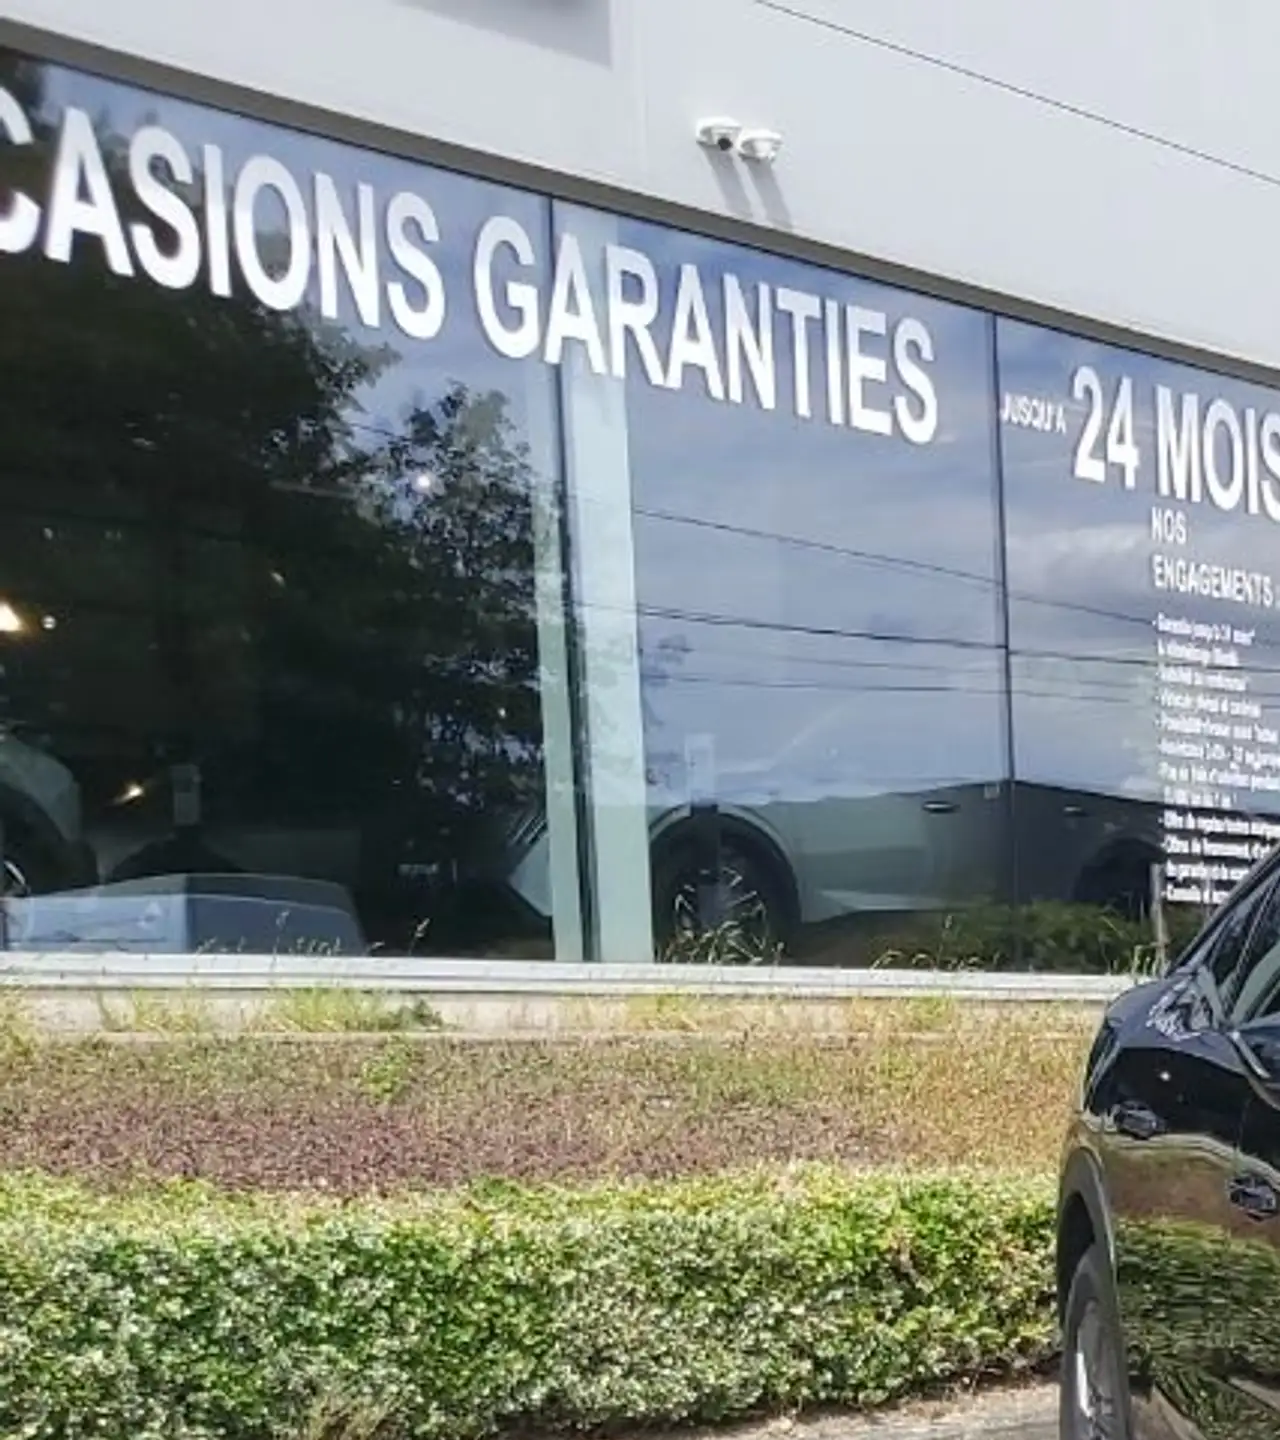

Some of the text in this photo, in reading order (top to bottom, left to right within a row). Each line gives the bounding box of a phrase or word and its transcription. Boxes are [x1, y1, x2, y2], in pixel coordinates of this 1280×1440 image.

[472, 215, 937, 444] GARANTIES
[1072, 365, 1140, 491] 24
[1151, 506, 1187, 545] NOS
